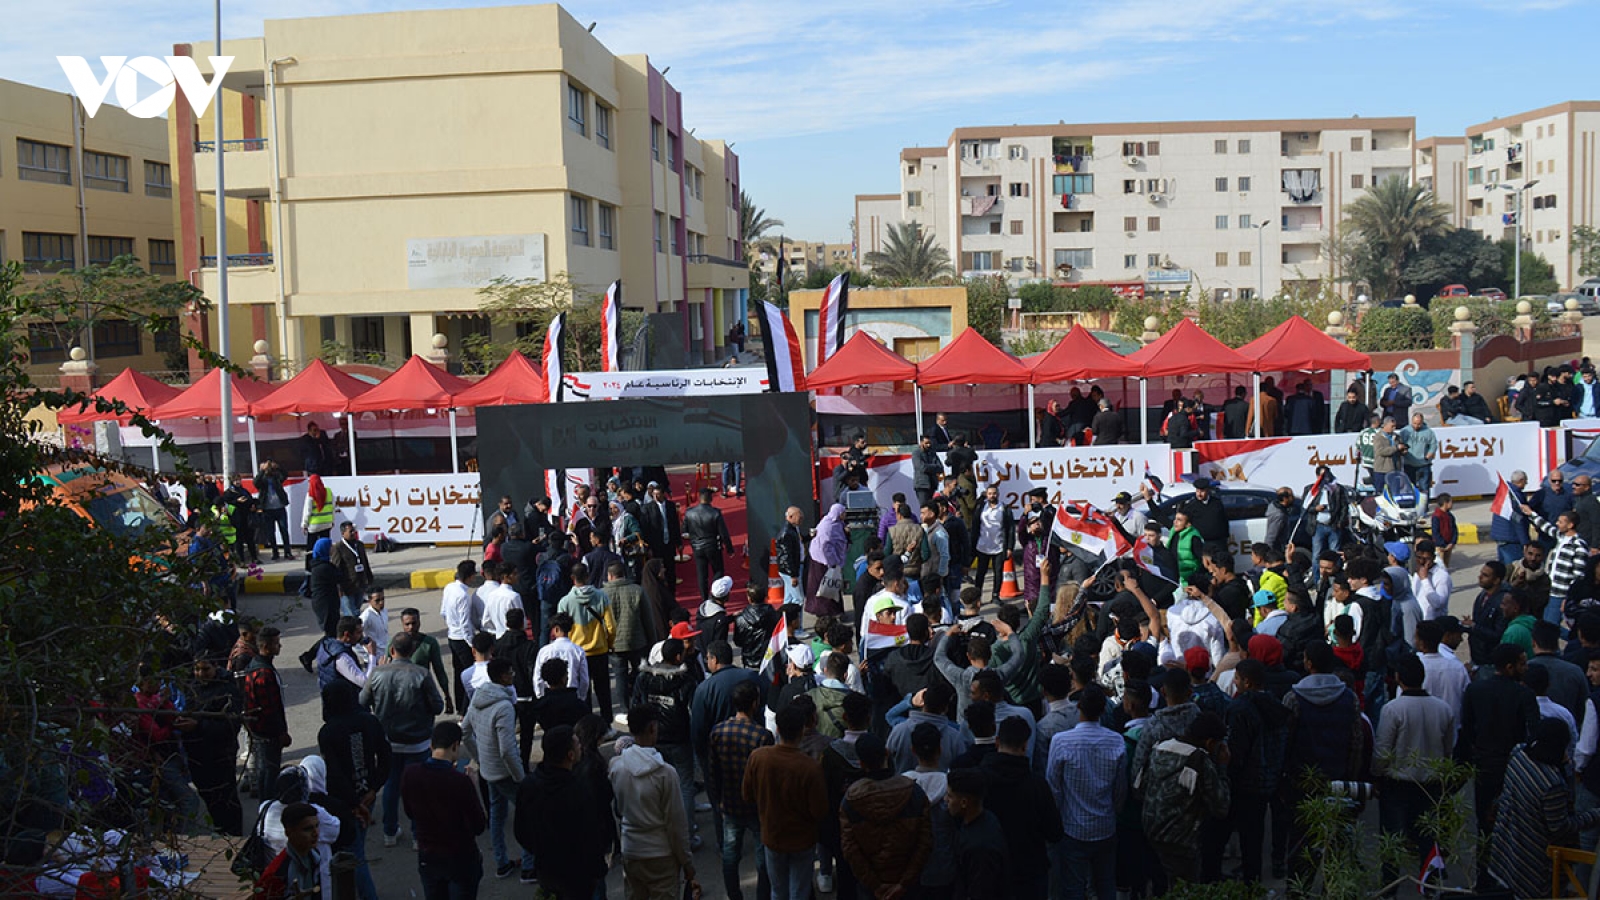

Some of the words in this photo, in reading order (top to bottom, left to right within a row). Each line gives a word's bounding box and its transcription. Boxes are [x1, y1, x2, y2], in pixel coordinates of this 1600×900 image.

[624, 379, 644, 391] عام
[646, 379, 691, 390] الرئاسية
[694, 377, 747, 389] الإنتخابات
[1435, 436, 1504, 464] الإنتخا
[1029, 457, 1133, 486] الإنتخابات
[335, 485, 399, 513] الرئاسي
[408, 483, 482, 512] نتخابات
[387, 516, 441, 534] 2024
